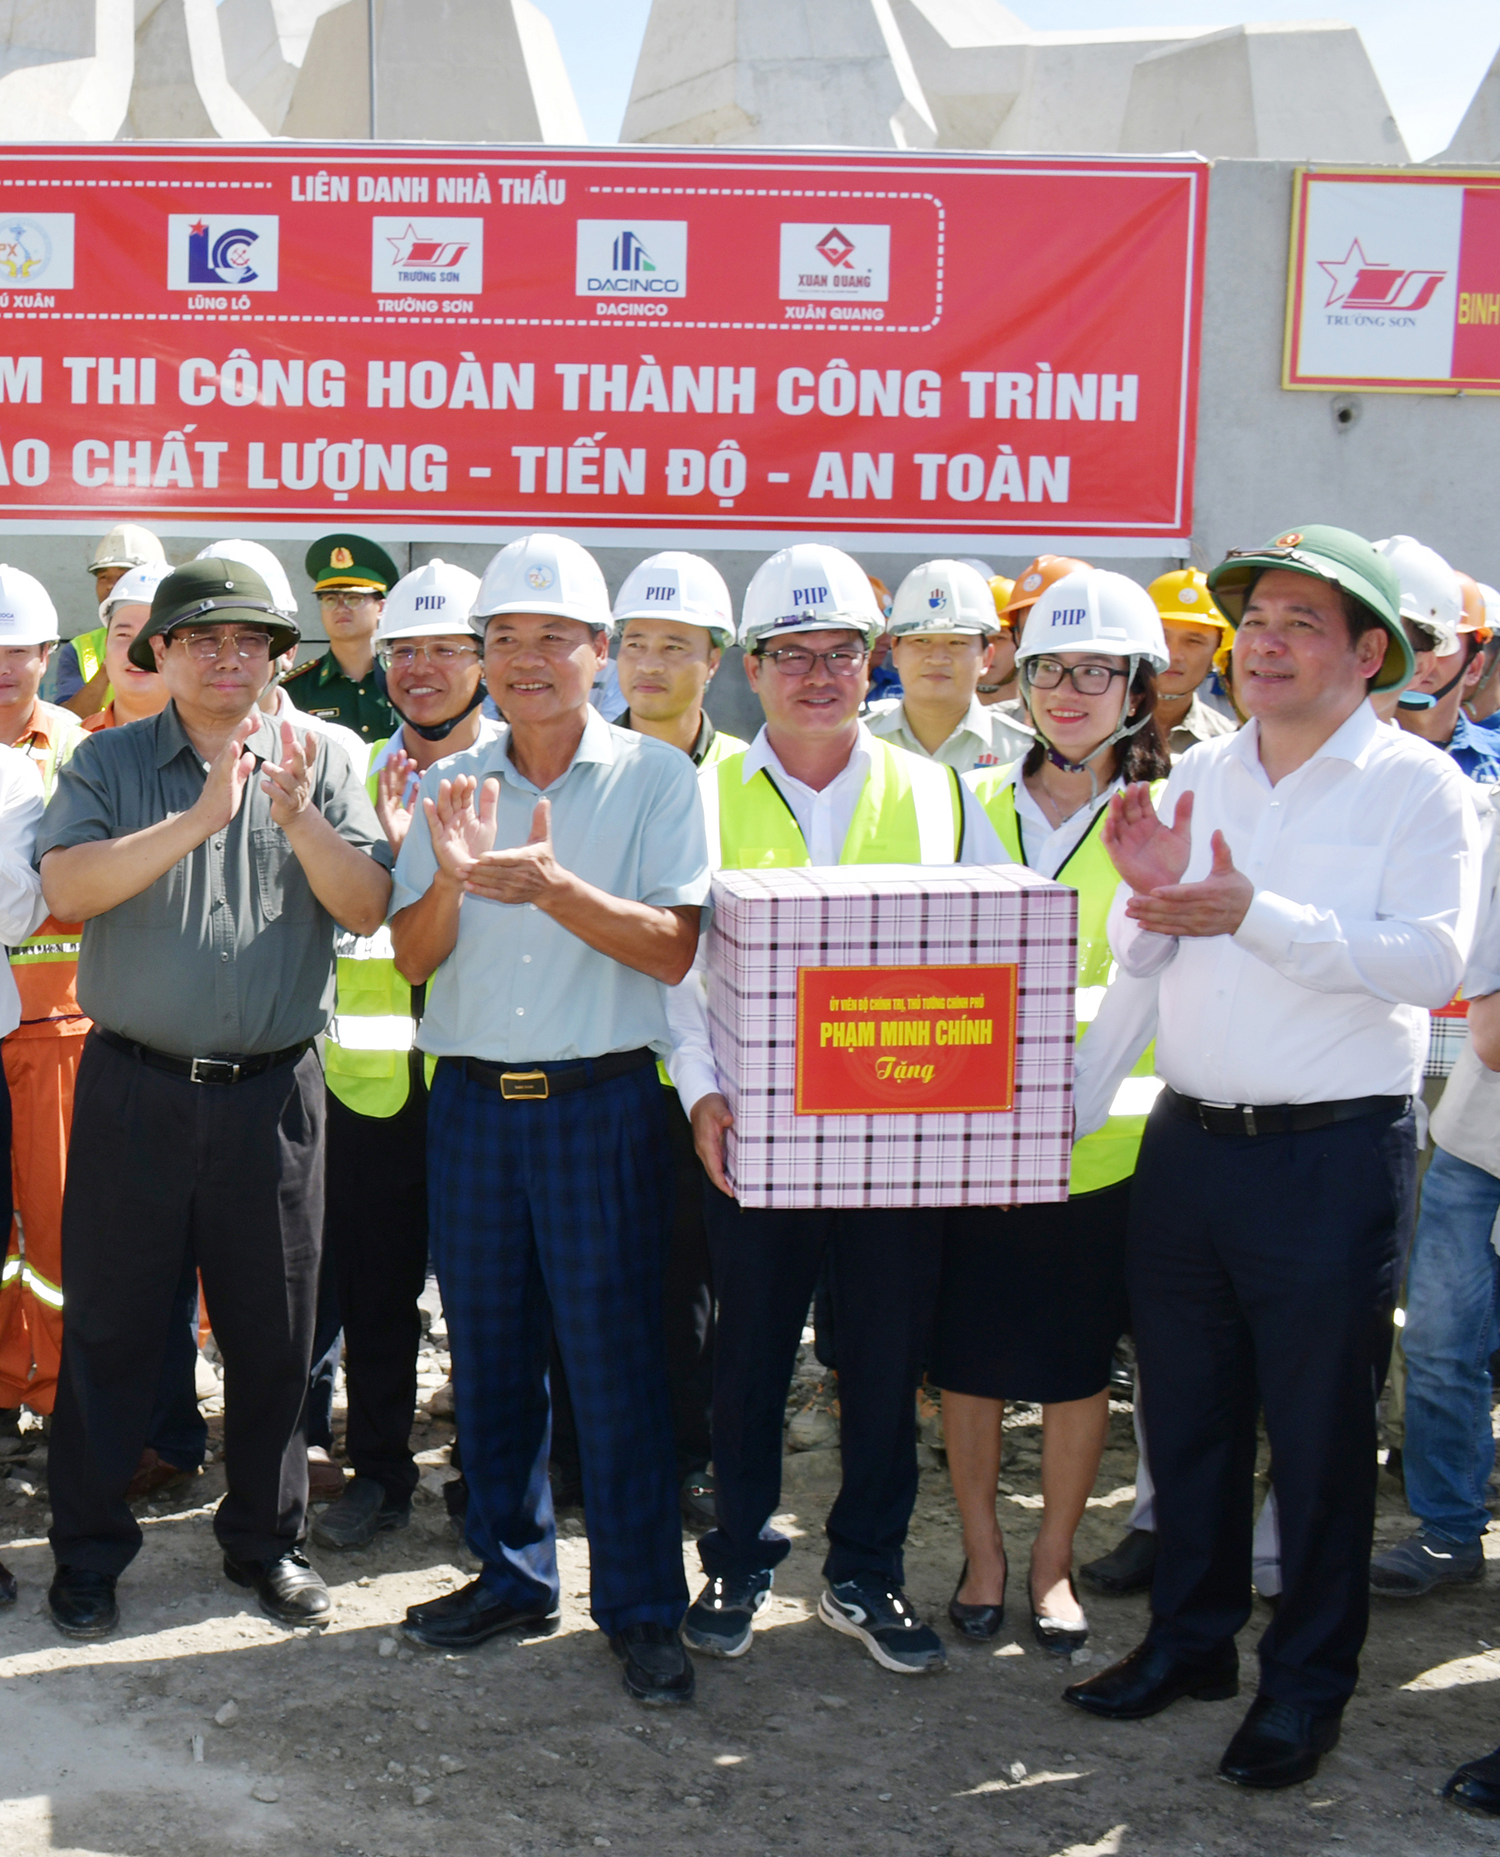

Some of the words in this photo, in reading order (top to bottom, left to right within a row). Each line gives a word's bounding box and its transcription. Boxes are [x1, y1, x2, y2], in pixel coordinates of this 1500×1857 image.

[291, 170, 350, 202] LIÊN
[357, 176, 429, 203] DANH
[436, 172, 492, 204] NHÀ
[587, 278, 679, 292] DACINCO
[13, 292, 55, 308] XUÂN
[187, 294, 228, 310] LŨNG
[231, 294, 251, 310] LÔ
[377, 297, 439, 312] TRƯỜNG
[442, 299, 473, 313] SƠN
[596, 302, 669, 316] DACINCO
[1458, 292, 1500, 325] BINH
[784, 303, 827, 319] XUÂN
[830, 307, 884, 320] QUANG
[62, 356, 157, 405] THI
[178, 347, 346, 408] CÔNG
[367, 351, 535, 411] HOÀN
[554, 354, 756, 414] THÀNH
[776, 357, 942, 418] CÔNG
[960, 361, 1139, 422] TRÌNH
[71, 424, 228, 489] CHẤT
[247, 438, 449, 502] LƯỢNG
[511, 432, 646, 495] TIẾN
[664, 439, 747, 508] ĐỘ
[807, 451, 894, 500] AN
[913, 444, 1071, 503] TOÀN
[414, 594, 446, 611] PIIP
[645, 586, 676, 601] PIIP
[792, 586, 828, 606] PIIP
[1050, 608, 1086, 627] PIIP
[820, 1021, 875, 1053] PHẠM
[880, 1020, 930, 1046] MINH
[935, 1014, 992, 1046] CHÍNH
[875, 1056, 935, 1084] Tặng
